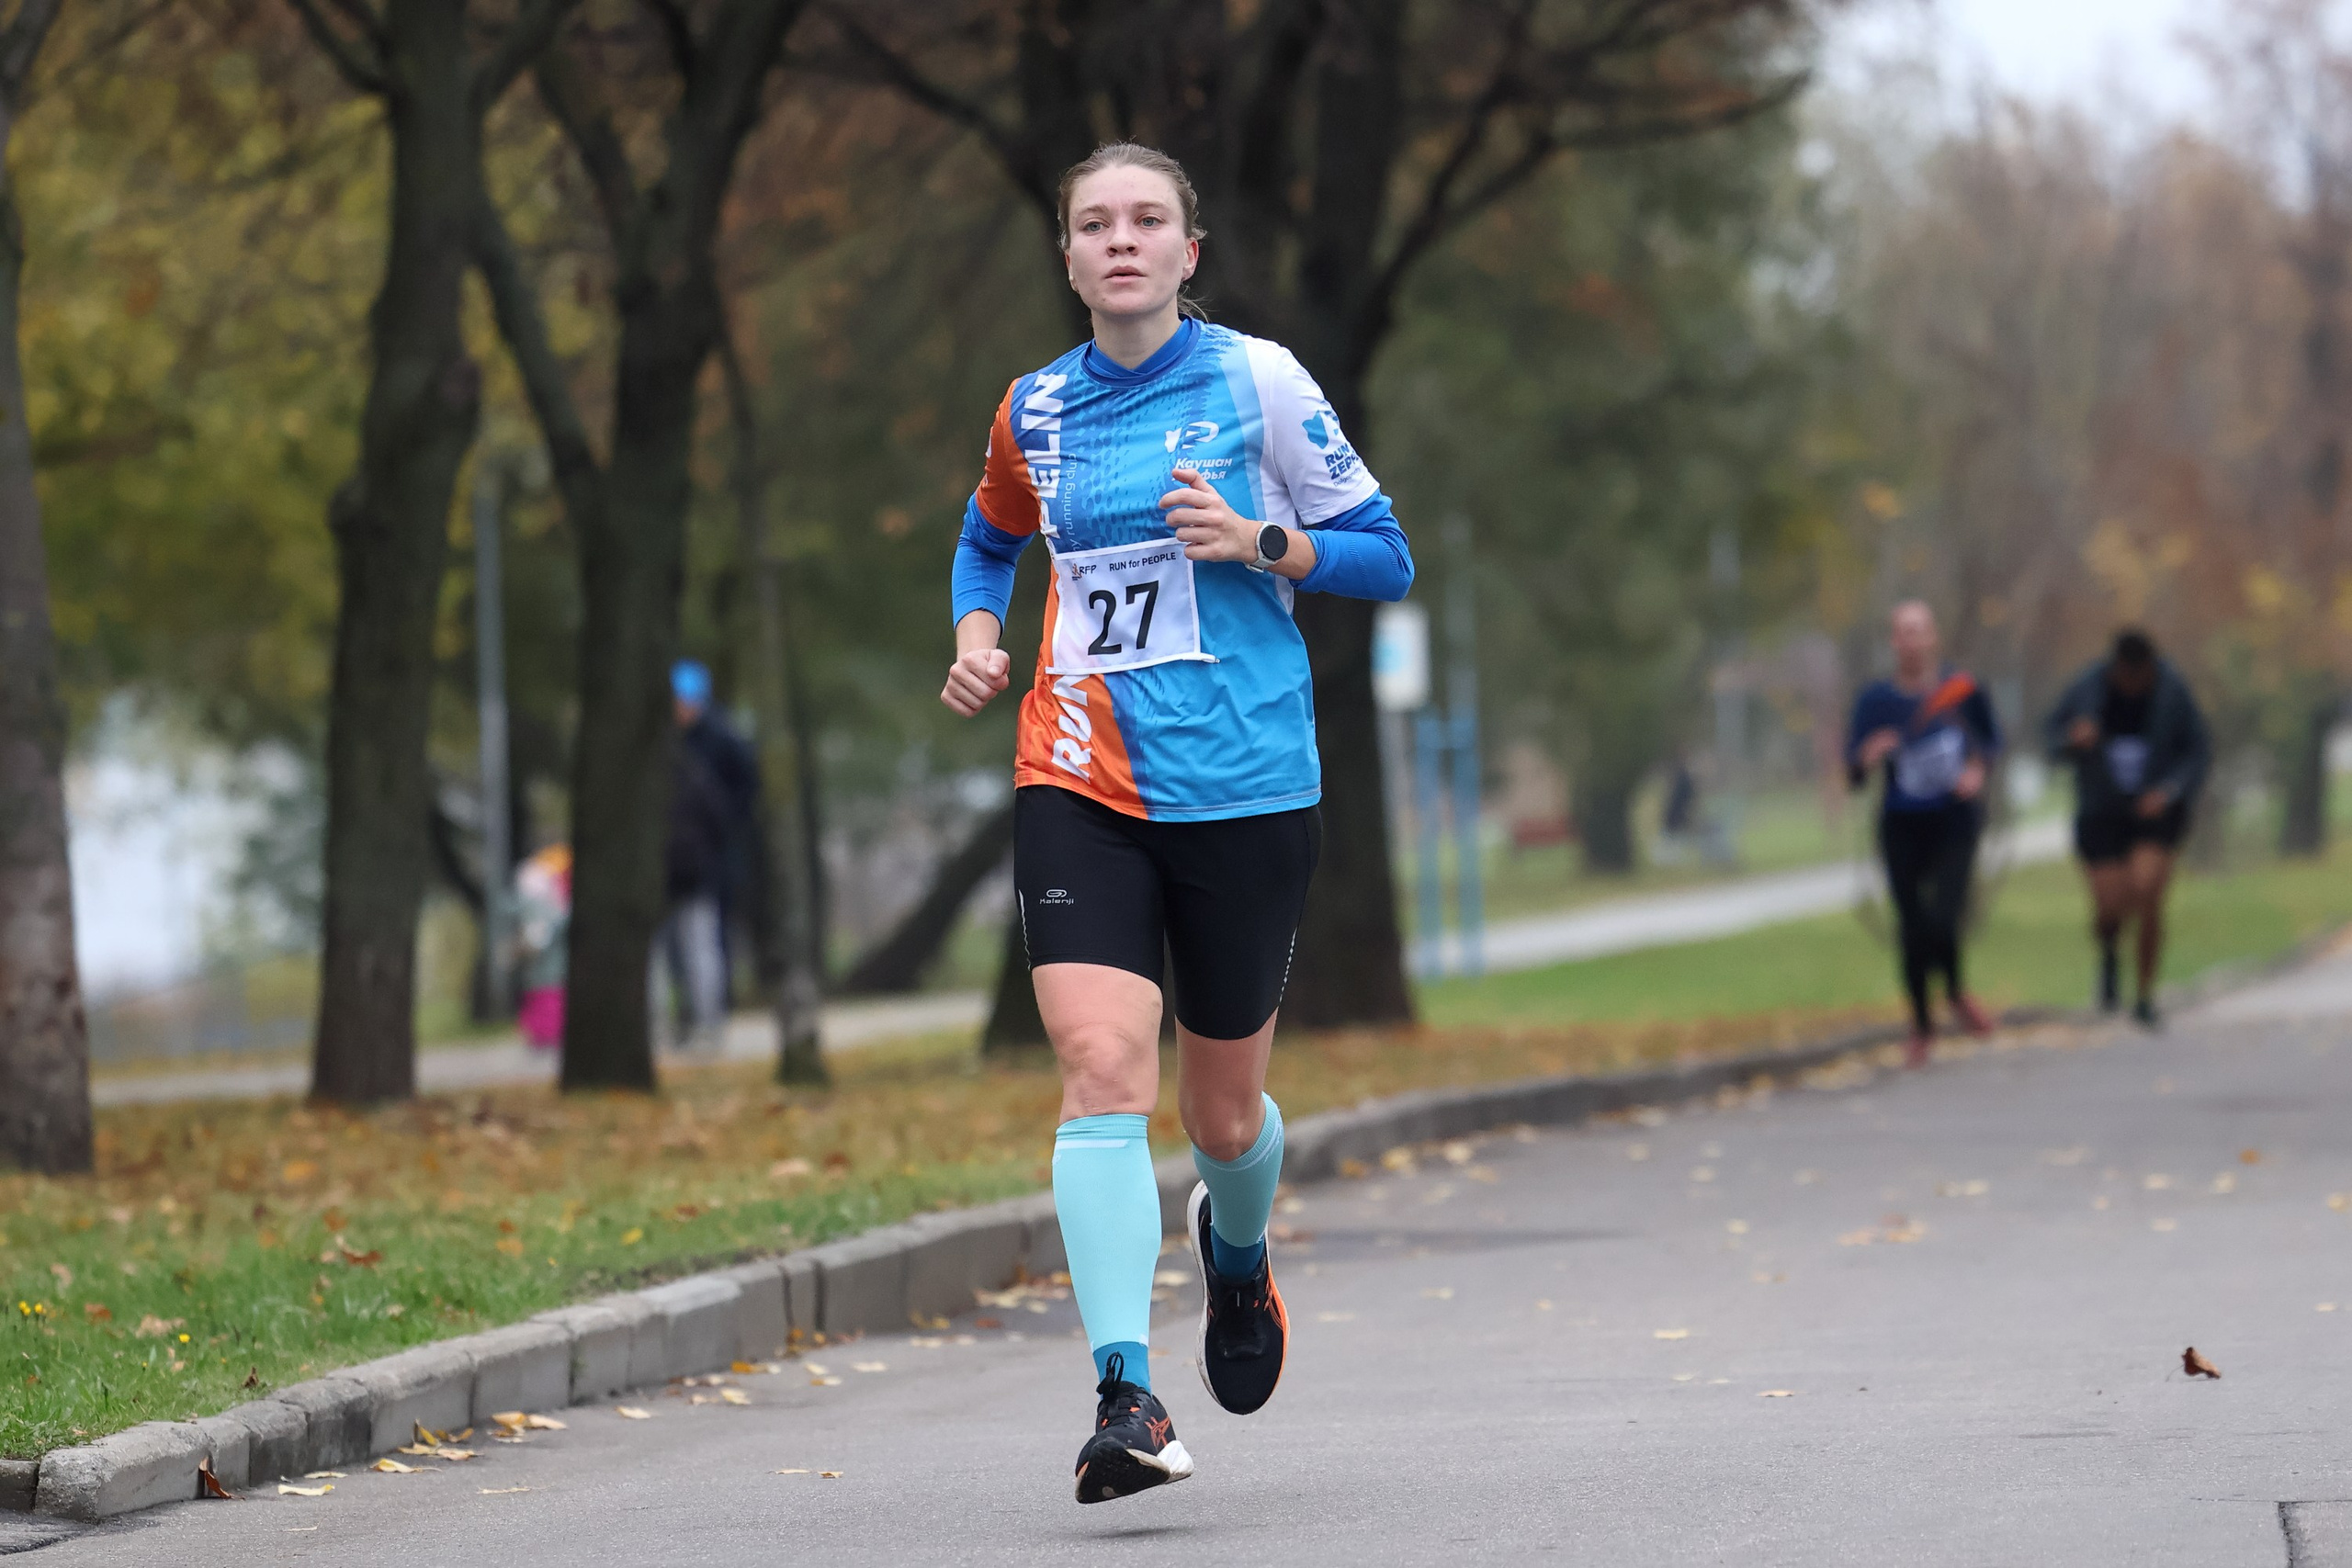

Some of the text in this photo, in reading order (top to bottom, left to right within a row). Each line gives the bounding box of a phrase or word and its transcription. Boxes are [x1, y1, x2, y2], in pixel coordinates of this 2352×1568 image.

[1066, 453, 1078, 479] club
[1176, 457, 1233, 469] Каушан
[1325, 443, 1350, 468] RUN
[1062, 480, 1077, 536] running
[1079, 564, 1096, 575] RFP
[1109, 552, 1176, 571] RUN for PEOPLE
[1087, 580, 1159, 656] 27
[1039, 897, 1075, 906] Kalenji
